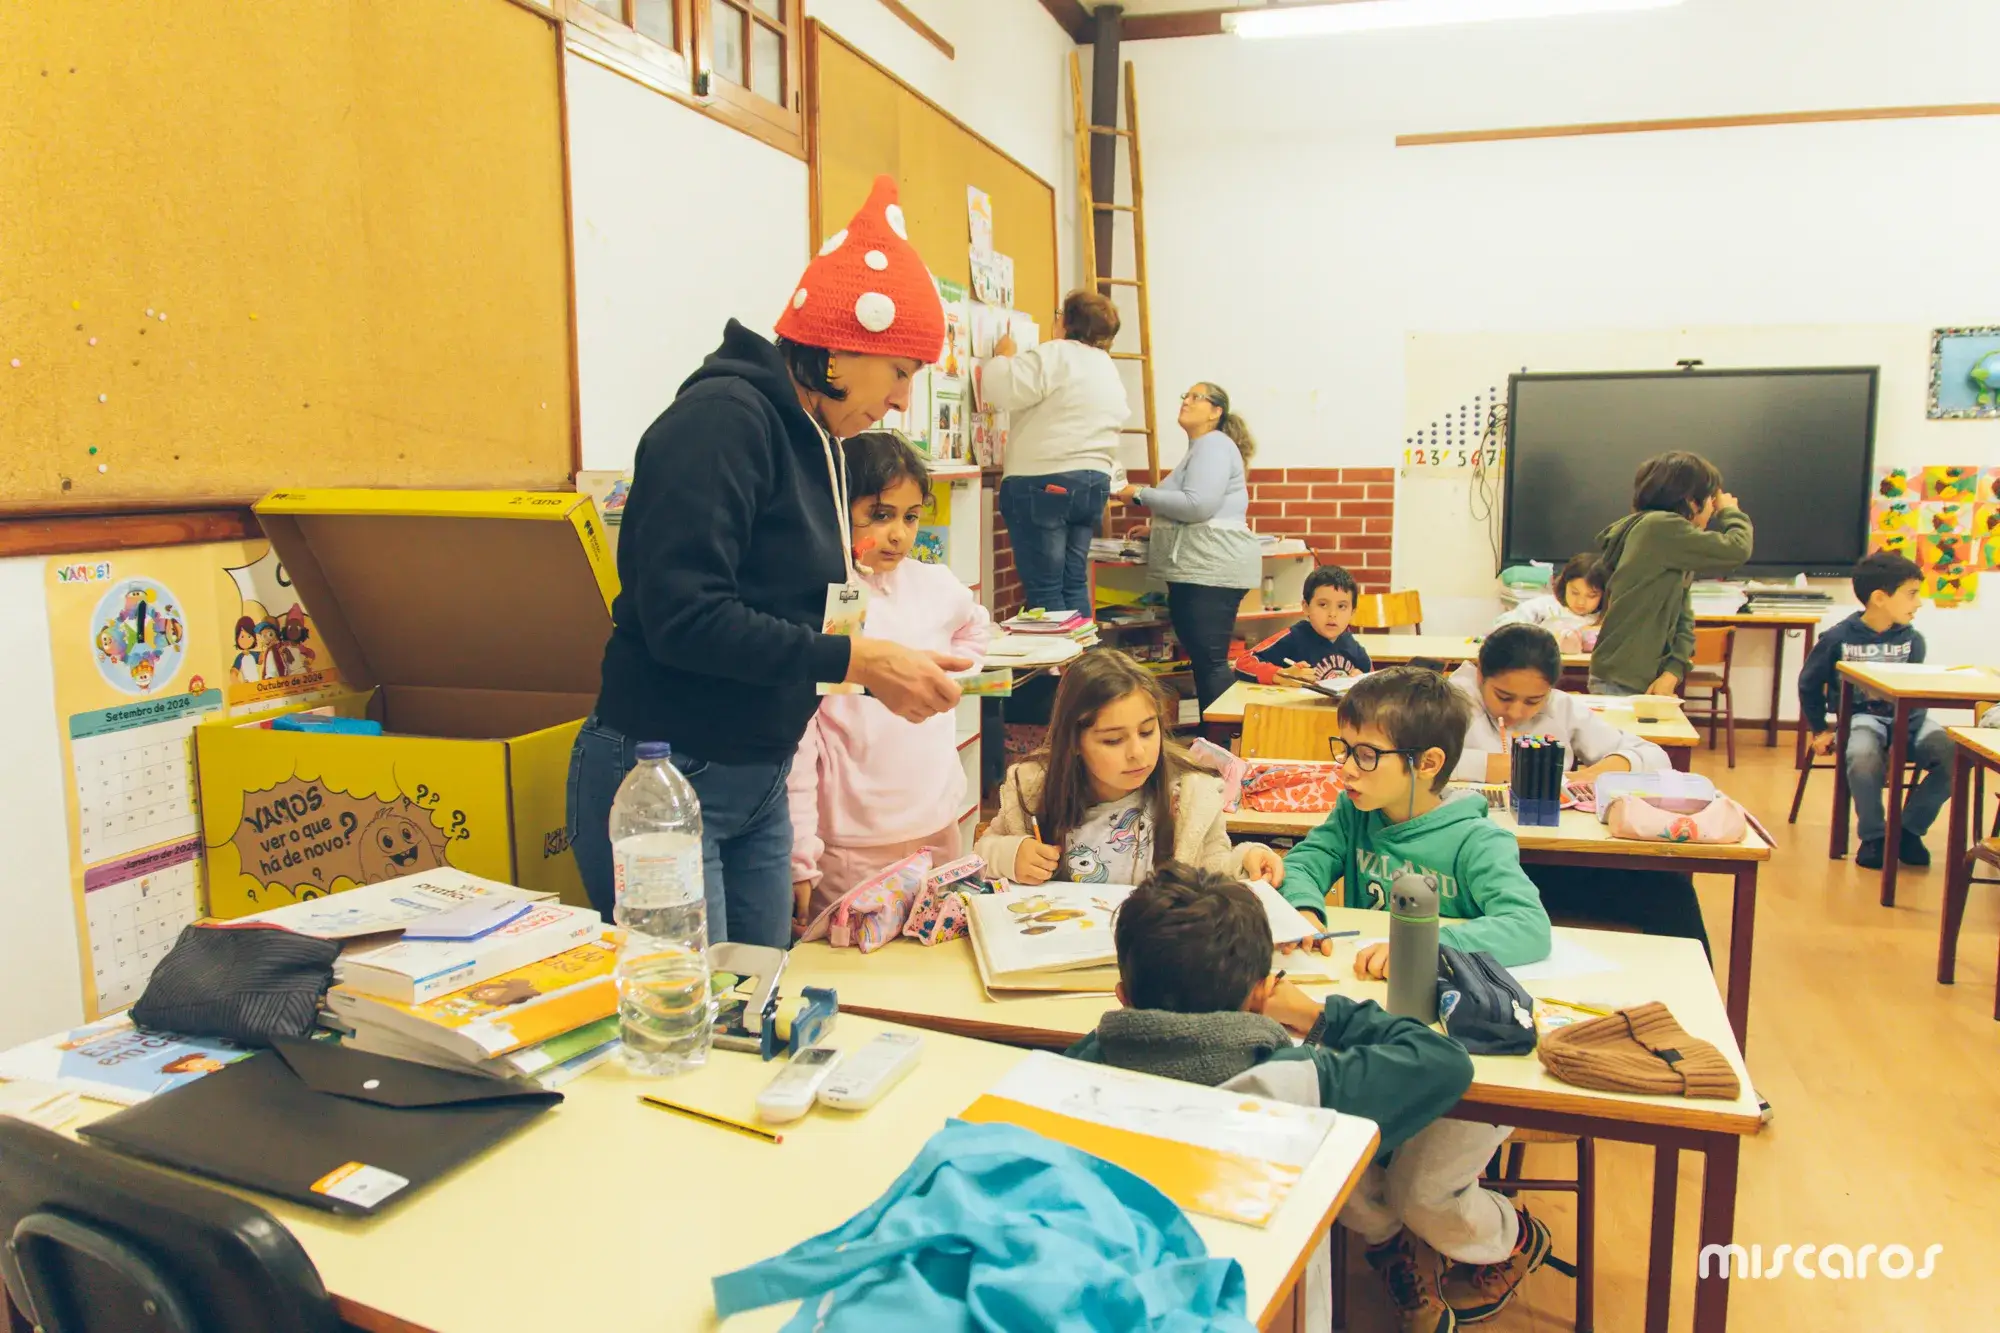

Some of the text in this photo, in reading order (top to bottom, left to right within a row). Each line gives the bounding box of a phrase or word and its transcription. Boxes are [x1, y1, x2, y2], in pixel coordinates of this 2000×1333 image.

[1404, 448, 1411, 465] 1
[1415, 448, 1426, 464] 2
[1430, 449, 1440, 466] 3
[1457, 449, 1466, 467] 5
[1471, 449, 1482, 466] 6
[1486, 449, 1496, 466] 7
[58, 563, 110, 582] VAMOS!
[1842, 640, 1912, 657] WILD LIFE
[256, 679, 290, 692] Outubro
[291, 677, 301, 686] de
[303, 672, 324, 684] 2024
[105, 705, 153, 722] Setembro
[154, 703, 165, 713] de
[167, 698, 191, 710] 2024
[244, 786, 322, 833] VAMOS
[260, 817, 332, 853] ver o que
[160, 849, 173, 859] de
[259, 854, 282, 876] há
[283, 848, 303, 868] de
